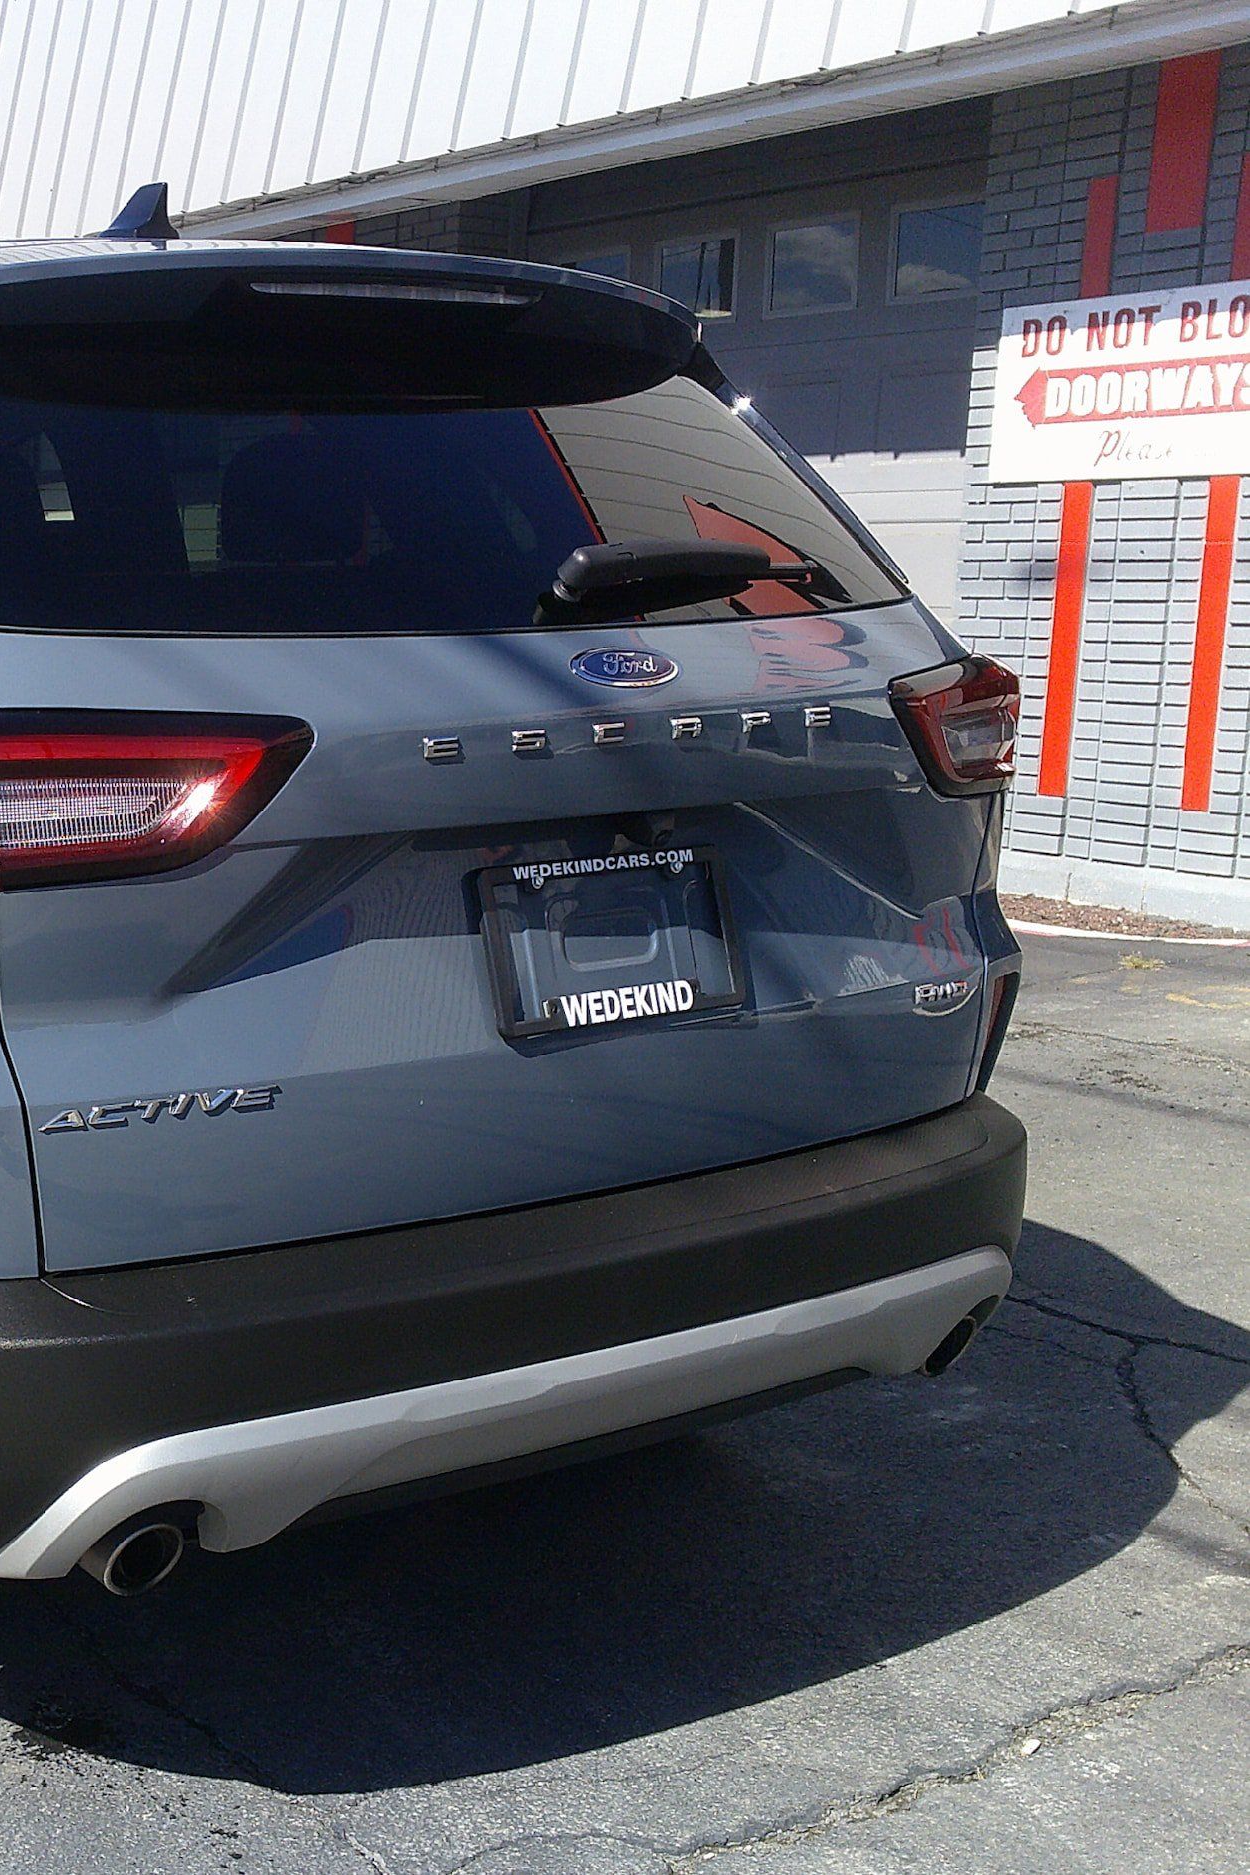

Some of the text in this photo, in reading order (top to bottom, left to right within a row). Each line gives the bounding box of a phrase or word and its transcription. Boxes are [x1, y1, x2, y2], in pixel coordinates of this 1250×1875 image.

[1021, 314, 1067, 357] DO
[1086, 305, 1162, 351] NOT
[602, 651, 659, 675] Ford
[422, 706, 832, 760] ESCAPE
[512, 849, 694, 881] WEDEKINDCARS.COM
[560, 979, 694, 1027] WEDEKIND
[38, 1084, 282, 1134] ACTIVE
